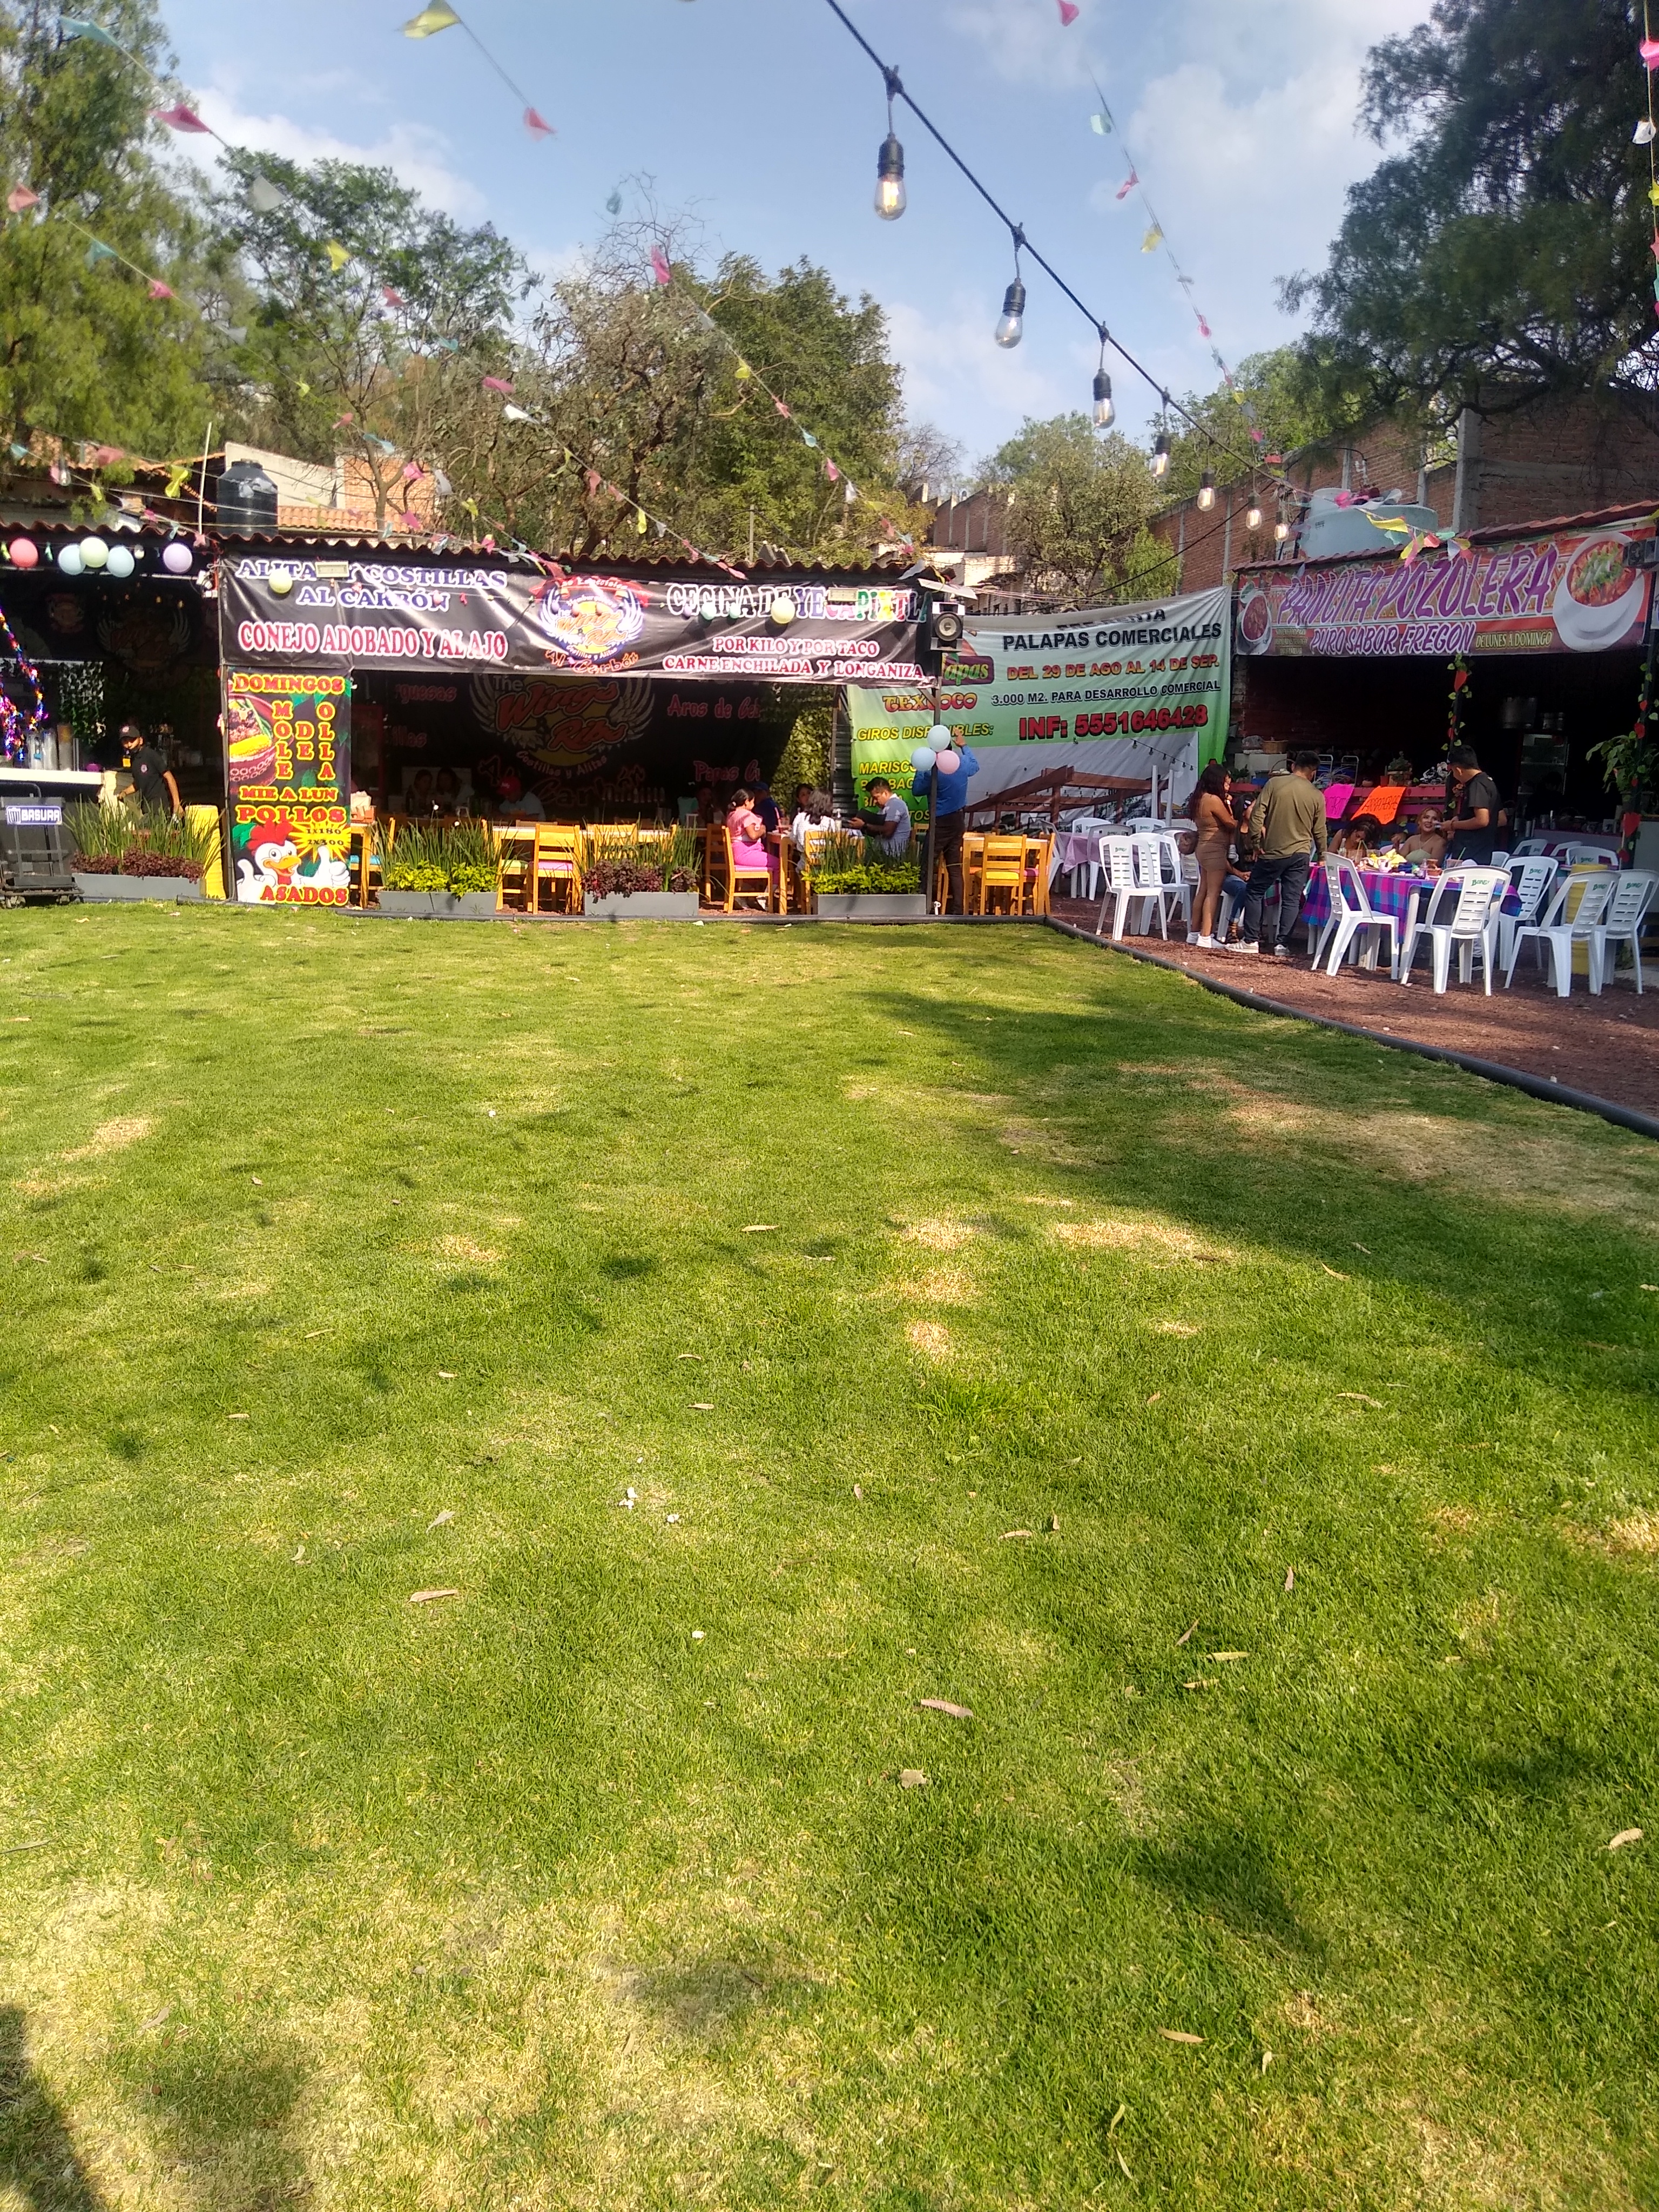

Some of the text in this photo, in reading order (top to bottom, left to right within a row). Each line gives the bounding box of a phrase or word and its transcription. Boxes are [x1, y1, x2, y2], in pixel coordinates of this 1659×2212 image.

[362, 564, 507, 589] COSTILLAS
[1277, 543, 1558, 626] PANCITA POZOLERA
[295, 586, 450, 612] AL CARBÓN
[667, 583, 757, 618] CECINA
[555, 609, 623, 631] Wings
[238, 621, 508, 660] CONEJO ADOBADO Y AL AJO
[585, 628, 628, 647] Ribs
[713, 636, 880, 658] POR KILO Y POR TACO
[1003, 623, 1222, 651] PALAPAS COMERCIALES
[1310, 621, 1476, 656] PURO SABOR FREGON
[1475, 630, 1553, 648] DE LUNES A DOMINGO
[545, 650, 638, 673] Al Carbón
[662, 655, 925, 680] CARNE ENCHILADA Y LONGANIZA
[1007, 654, 1220, 680] DEL 29 DE AGO AL 14 DE SEP.
[233, 673, 345, 694] DOMINGOS
[494, 676, 523, 692] The
[992, 680, 1222, 706] 3.000 M2. PARA DESARROLLO COMERCIAL
[495, 681, 619, 732] Wings
[667, 694, 708, 717] Aros
[714, 697, 733, 719] de
[547, 716, 628, 753] Ribs
[857, 723, 994, 741] GIROS DISPIBLES:
[1019, 704, 1209, 740] INF: 5551646428
[272, 700, 293, 780] MOLE
[295, 721, 314, 760] DE
[316, 702, 335, 780] OLLA
[516, 750, 608, 779] Costillas y Alitas
[693, 760, 740, 787] Papas
[279, 786, 298, 801] A
[22, 809, 60, 821] BASURA
[235, 805, 346, 825] POLLOS
[260, 885, 349, 906] ASADOS
